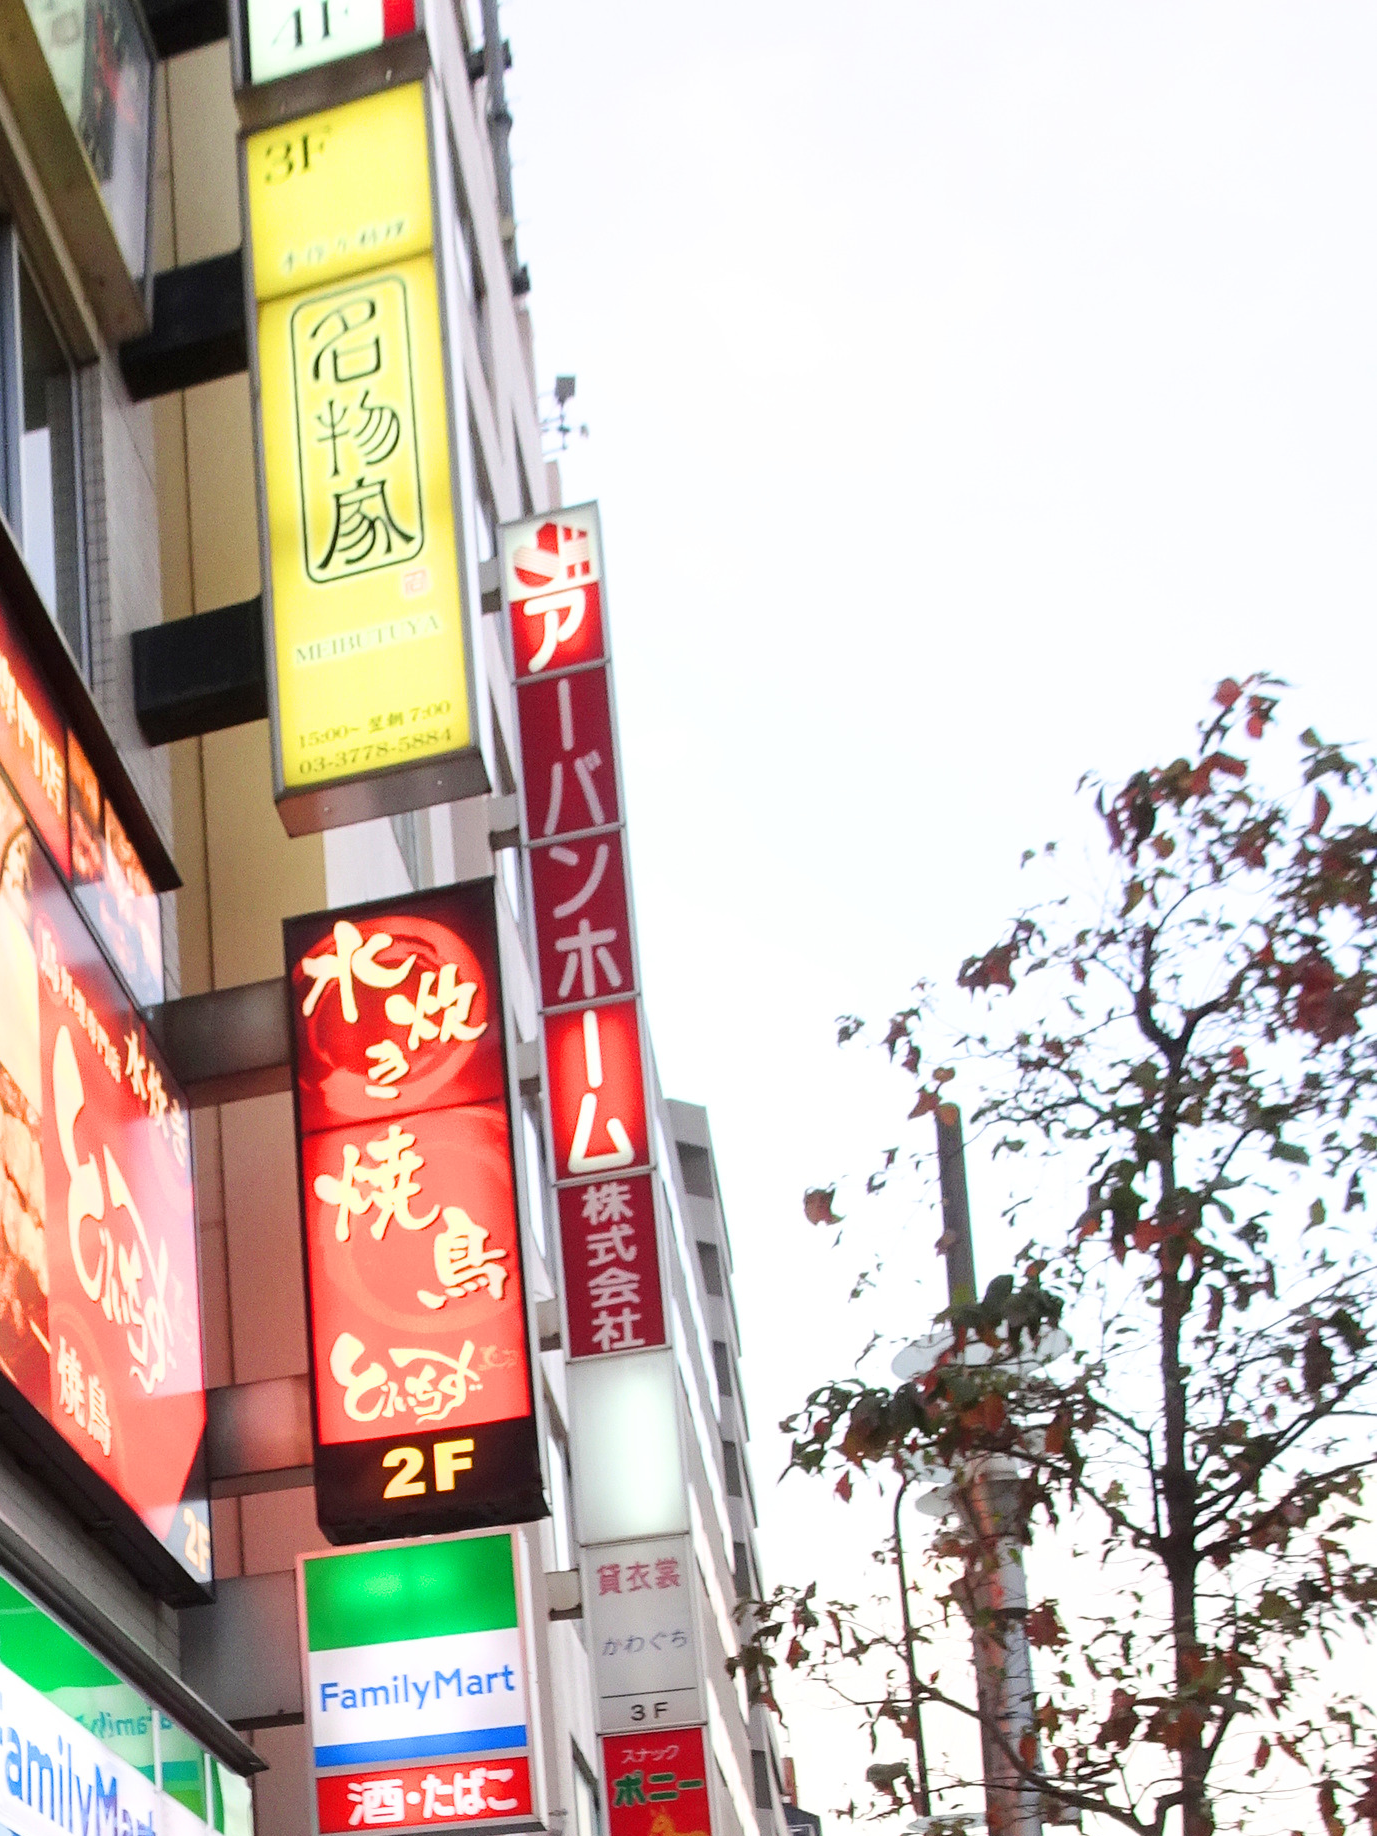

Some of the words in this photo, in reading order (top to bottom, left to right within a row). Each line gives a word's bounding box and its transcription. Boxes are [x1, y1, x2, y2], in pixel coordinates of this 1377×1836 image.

[264, 126, 331, 184] 3F
[309, 297, 415, 571] 名物家
[295, 613, 442, 666] MEIBUTUYA
[409, 701, 451, 723] 7:00
[299, 727, 452, 775] 03-3778-5884
[524, 590, 635, 1174] アーバンホーム
[302, 920, 488, 1101] 水炊き
[315, 1123, 508, 1310] 焼鳥
[581, 1181, 645, 1353] 株式会社
[381, 1437, 475, 1499] 2F
[182, 1507, 213, 1575] 2F
[601, 1629, 688, 1658] かわぐち
[319, 1661, 516, 1713] FamilyMart
[622, 1745, 680, 1764] スナック
